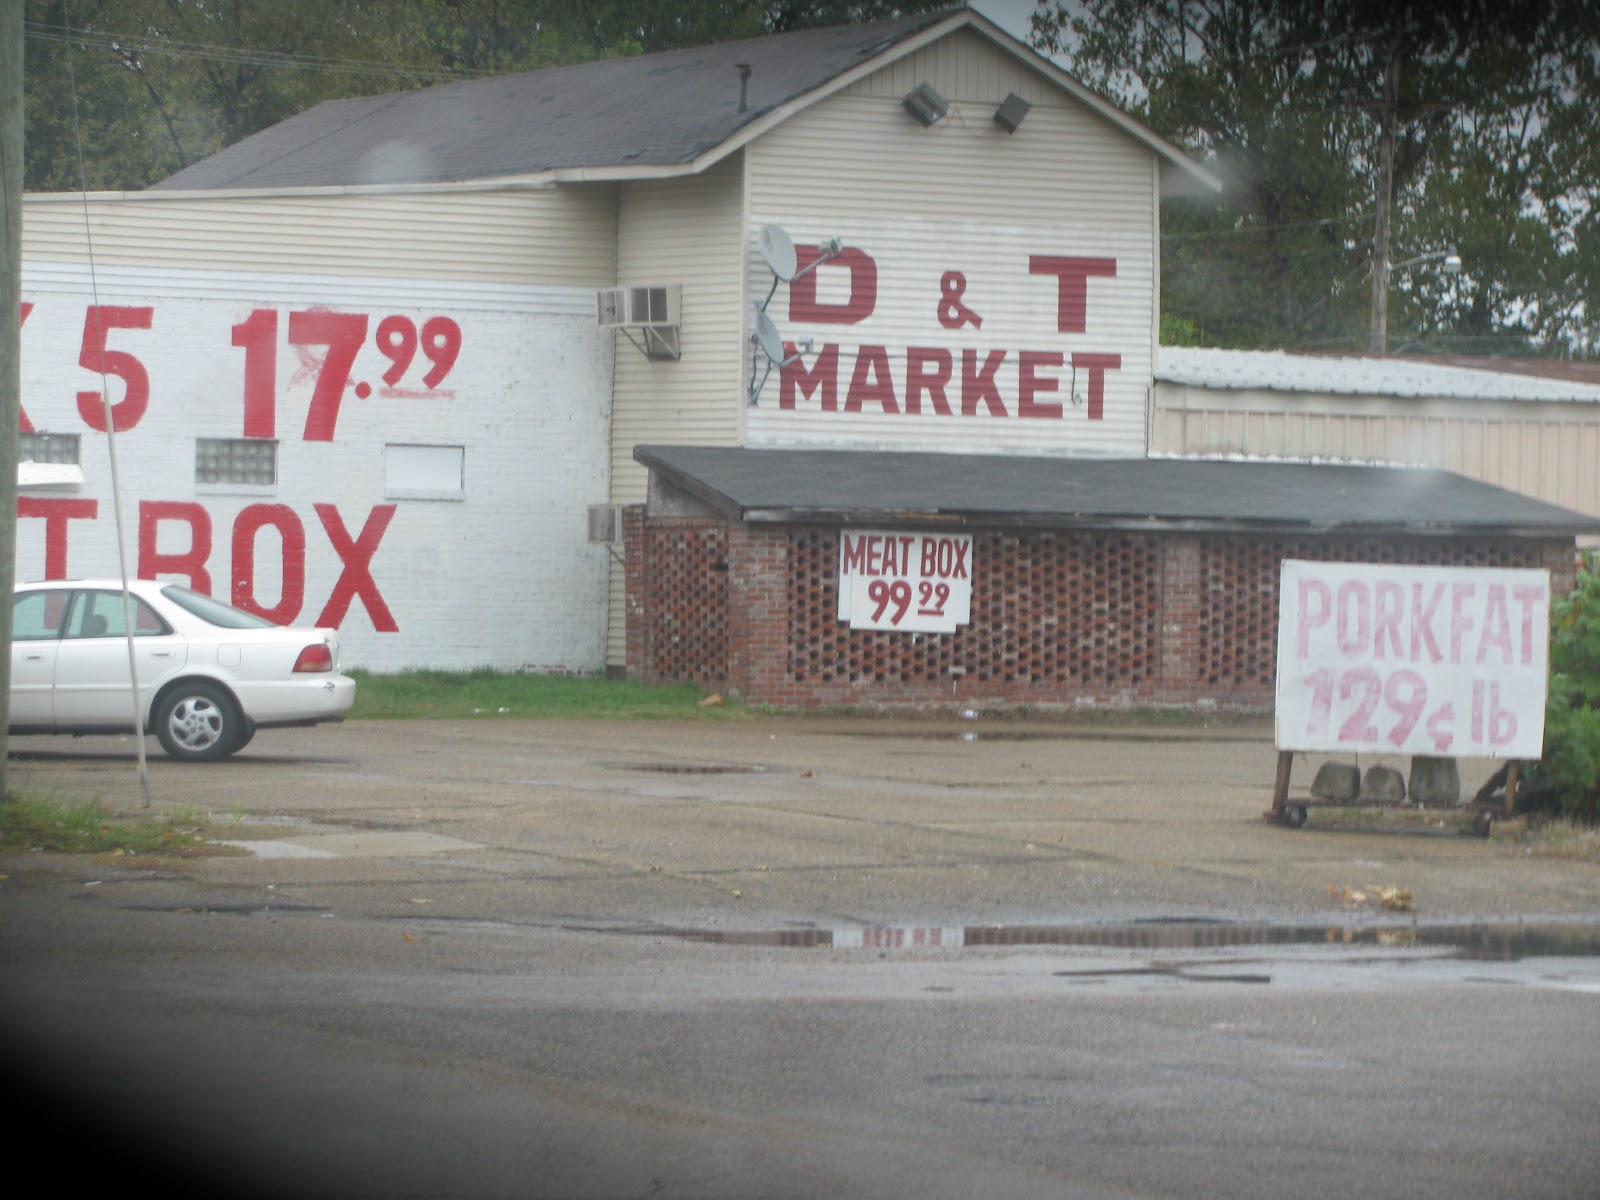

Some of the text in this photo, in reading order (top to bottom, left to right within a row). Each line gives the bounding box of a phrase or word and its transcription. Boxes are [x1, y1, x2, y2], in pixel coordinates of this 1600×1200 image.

[787, 243, 1117, 334] D & T
[76, 305, 154, 433] 5
[778, 340, 1122, 420] MARKET
[136, 500, 400, 632] BOX
[842, 534, 970, 579] MEAT BOX
